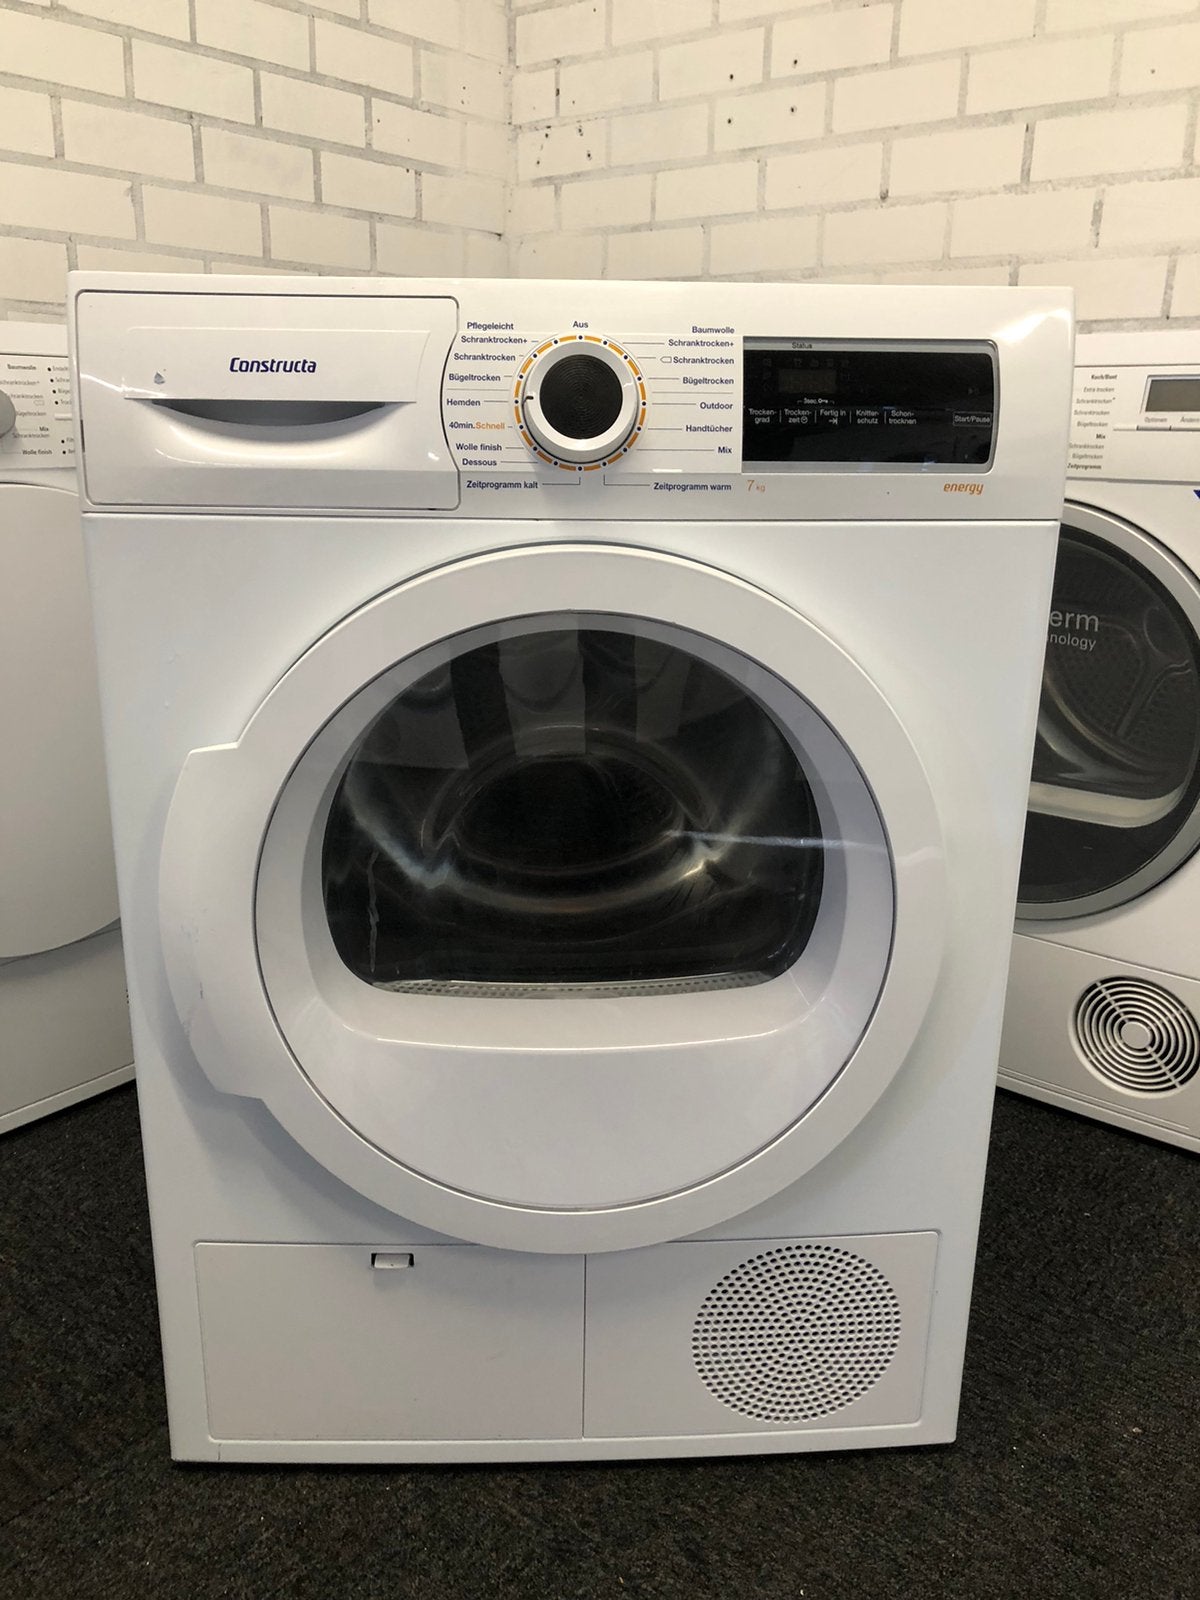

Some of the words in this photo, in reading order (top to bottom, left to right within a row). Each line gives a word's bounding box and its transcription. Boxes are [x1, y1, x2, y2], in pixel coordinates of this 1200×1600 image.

[466, 322, 514, 331] Pflegeleicht
[572, 321, 589, 329] Aus
[692, 326, 735, 334] Baumwolle
[461, 335, 528, 345] Schranktrocken+
[668, 339, 735, 348] Schranktrocken+
[791, 341, 813, 349] Status
[453, 353, 516, 362] Schranktrocken
[673, 356, 735, 365] Schranktrocken
[229, 357, 317, 373] Constructa
[448, 373, 501, 383] Bügeltrocken
[682, 376, 735, 386] Bügeltrocken
[446, 399, 481, 407] Hemden
[699, 402, 733, 410] Outdoor
[748, 408, 777, 416] Trocken-
[784, 408, 812, 416] Trocken-
[820, 409, 839, 417] Fertig
[754, 417, 771, 425] grad
[954, 415, 991, 423] Start/Pause
[685, 425, 733, 433] Handtücher
[455, 443, 479, 451] Wolle
[480, 443, 502, 451] finish
[718, 446, 733, 454] Mix
[462, 458, 498, 466] Dessous
[466, 480, 522, 490] Zeitprogramm
[523, 480, 539, 489] kalt
[653, 482, 708, 492] Zeitprogramm
[747, 479, 755, 491] 7
[756, 484, 766, 493] kg
[943, 483, 985, 496] energy
[1049, 633, 1097, 651] nology
